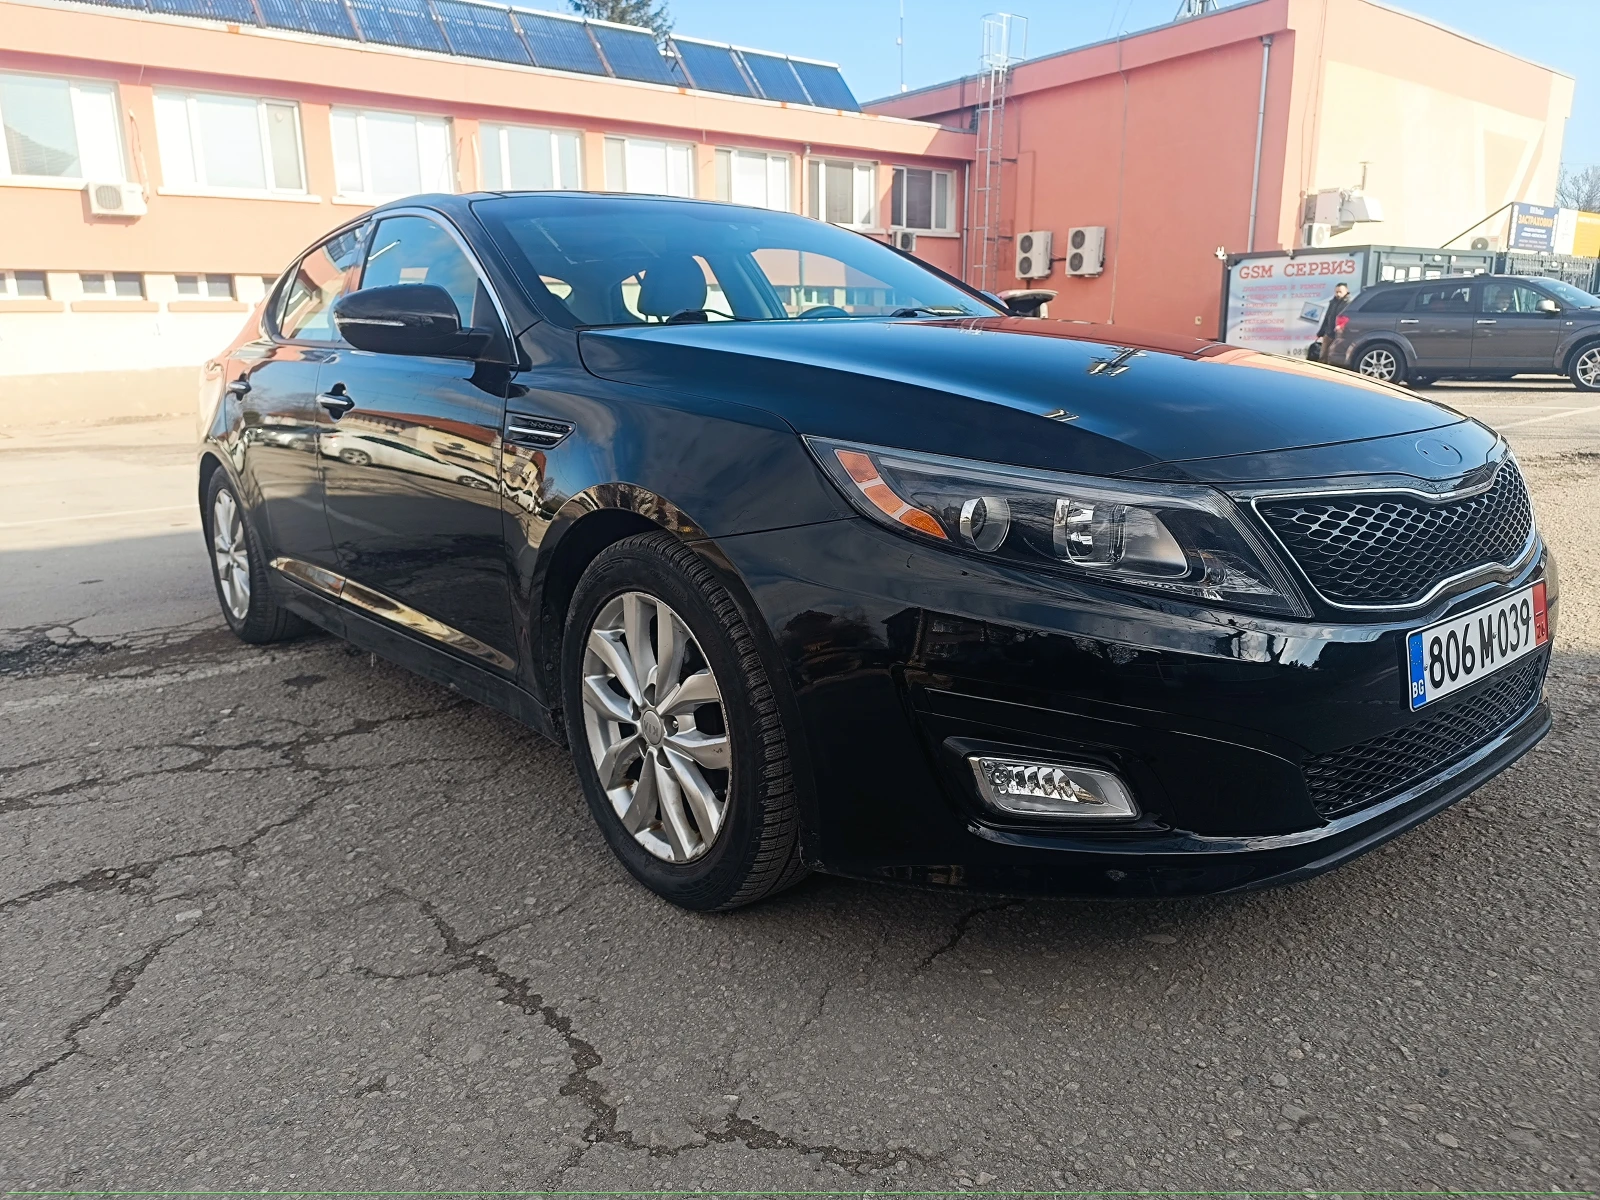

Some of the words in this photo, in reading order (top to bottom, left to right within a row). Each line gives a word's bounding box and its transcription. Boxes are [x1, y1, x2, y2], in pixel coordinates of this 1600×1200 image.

[1239, 265, 1273, 279] GSM
[1284, 260, 1355, 277] СЕРВИЗ
[1429, 622, 1476, 689] 806
[1478, 613, 1495, 669] M
[1497, 597, 1531, 658] 039
[1412, 679, 1425, 698] BG
